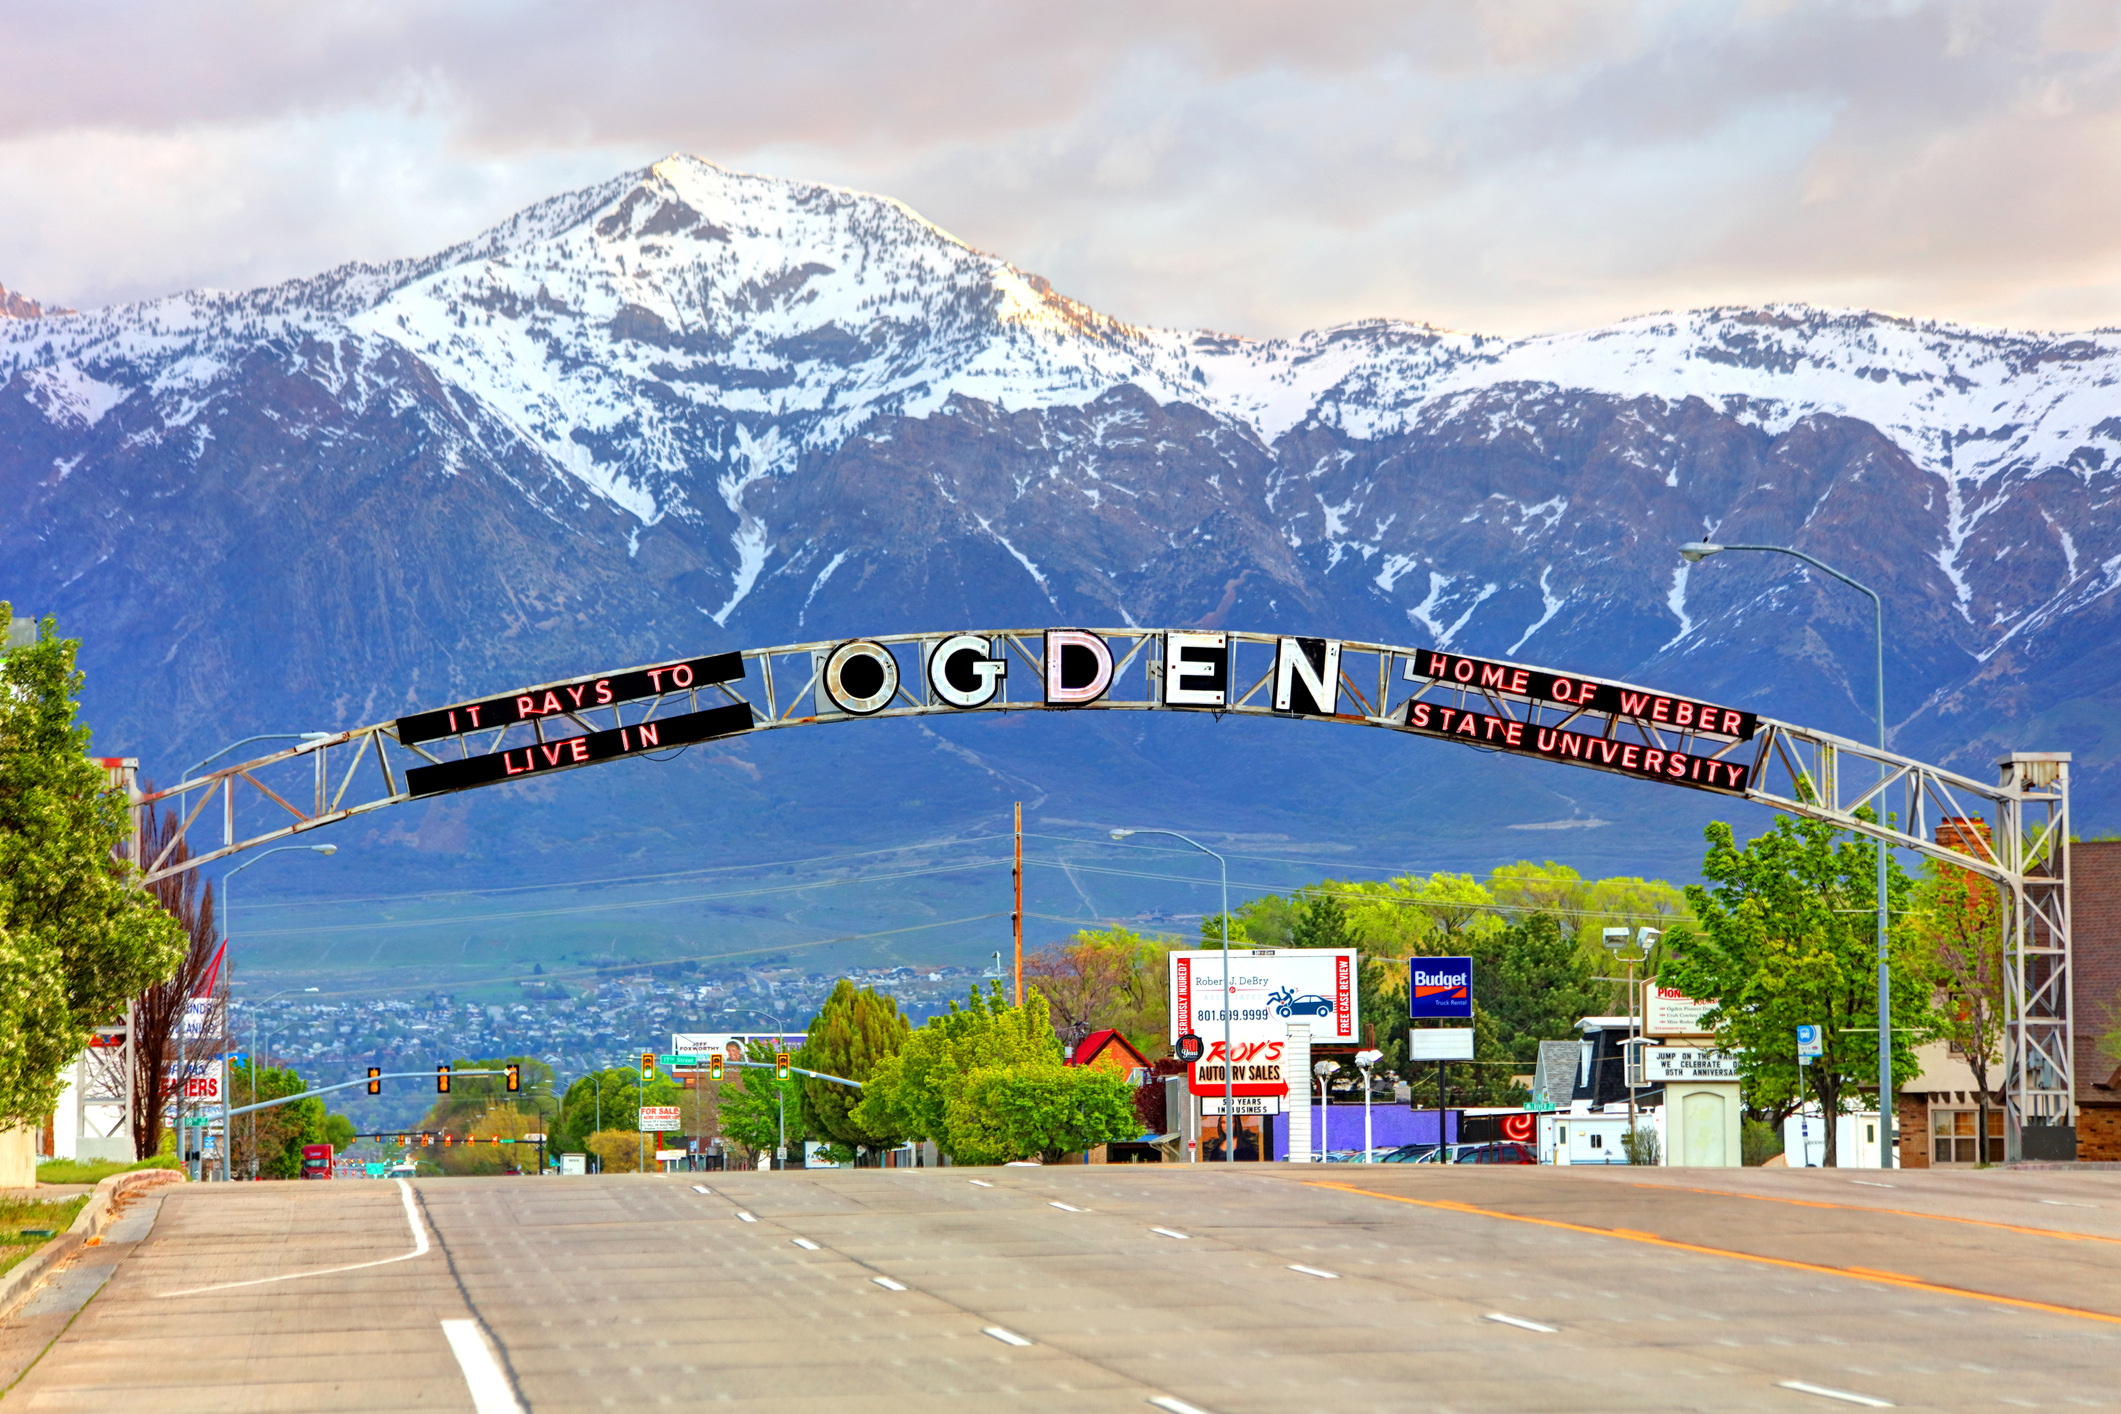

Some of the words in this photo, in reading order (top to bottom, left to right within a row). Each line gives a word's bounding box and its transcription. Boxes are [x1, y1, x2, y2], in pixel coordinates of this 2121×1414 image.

[825, 630, 1342, 714] OGDEN
[449, 705, 481, 732] IT
[516, 679, 613, 719] PAYS
[647, 664, 694, 692] TO
[1429, 653, 1530, 694] HOME
[1552, 678, 1598, 705] OF
[1620, 690, 1742, 735] WEBER
[503, 737, 590, 776] LIVE
[620, 723, 659, 752] IN
[1411, 704, 1524, 746] STATE
[1537, 728, 1745, 788] UNIVERSITY
[1178, 963, 1188, 995] INJURED?
[1196, 976, 1225, 986] Rober
[1239, 976, 1269, 987] DeBry
[1339, 961, 1349, 990] REVIEW
[1414, 971, 1467, 990] Budget
[1339, 992, 1350, 1012] CASE
[1178, 998, 1188, 1035] SERIOUSLY
[1340, 1013, 1350, 1033] FREE
[1183, 1039, 1198, 1052] 50
[1206, 1040, 1284, 1062] ROY'S
[1199, 1065, 1225, 1080] AUTO
[1232, 1065, 1245, 1080] RV
[1248, 1065, 1280, 1080] SALES
[641, 1107, 656, 1115] FOR
[658, 1107, 679, 1115] SALE
